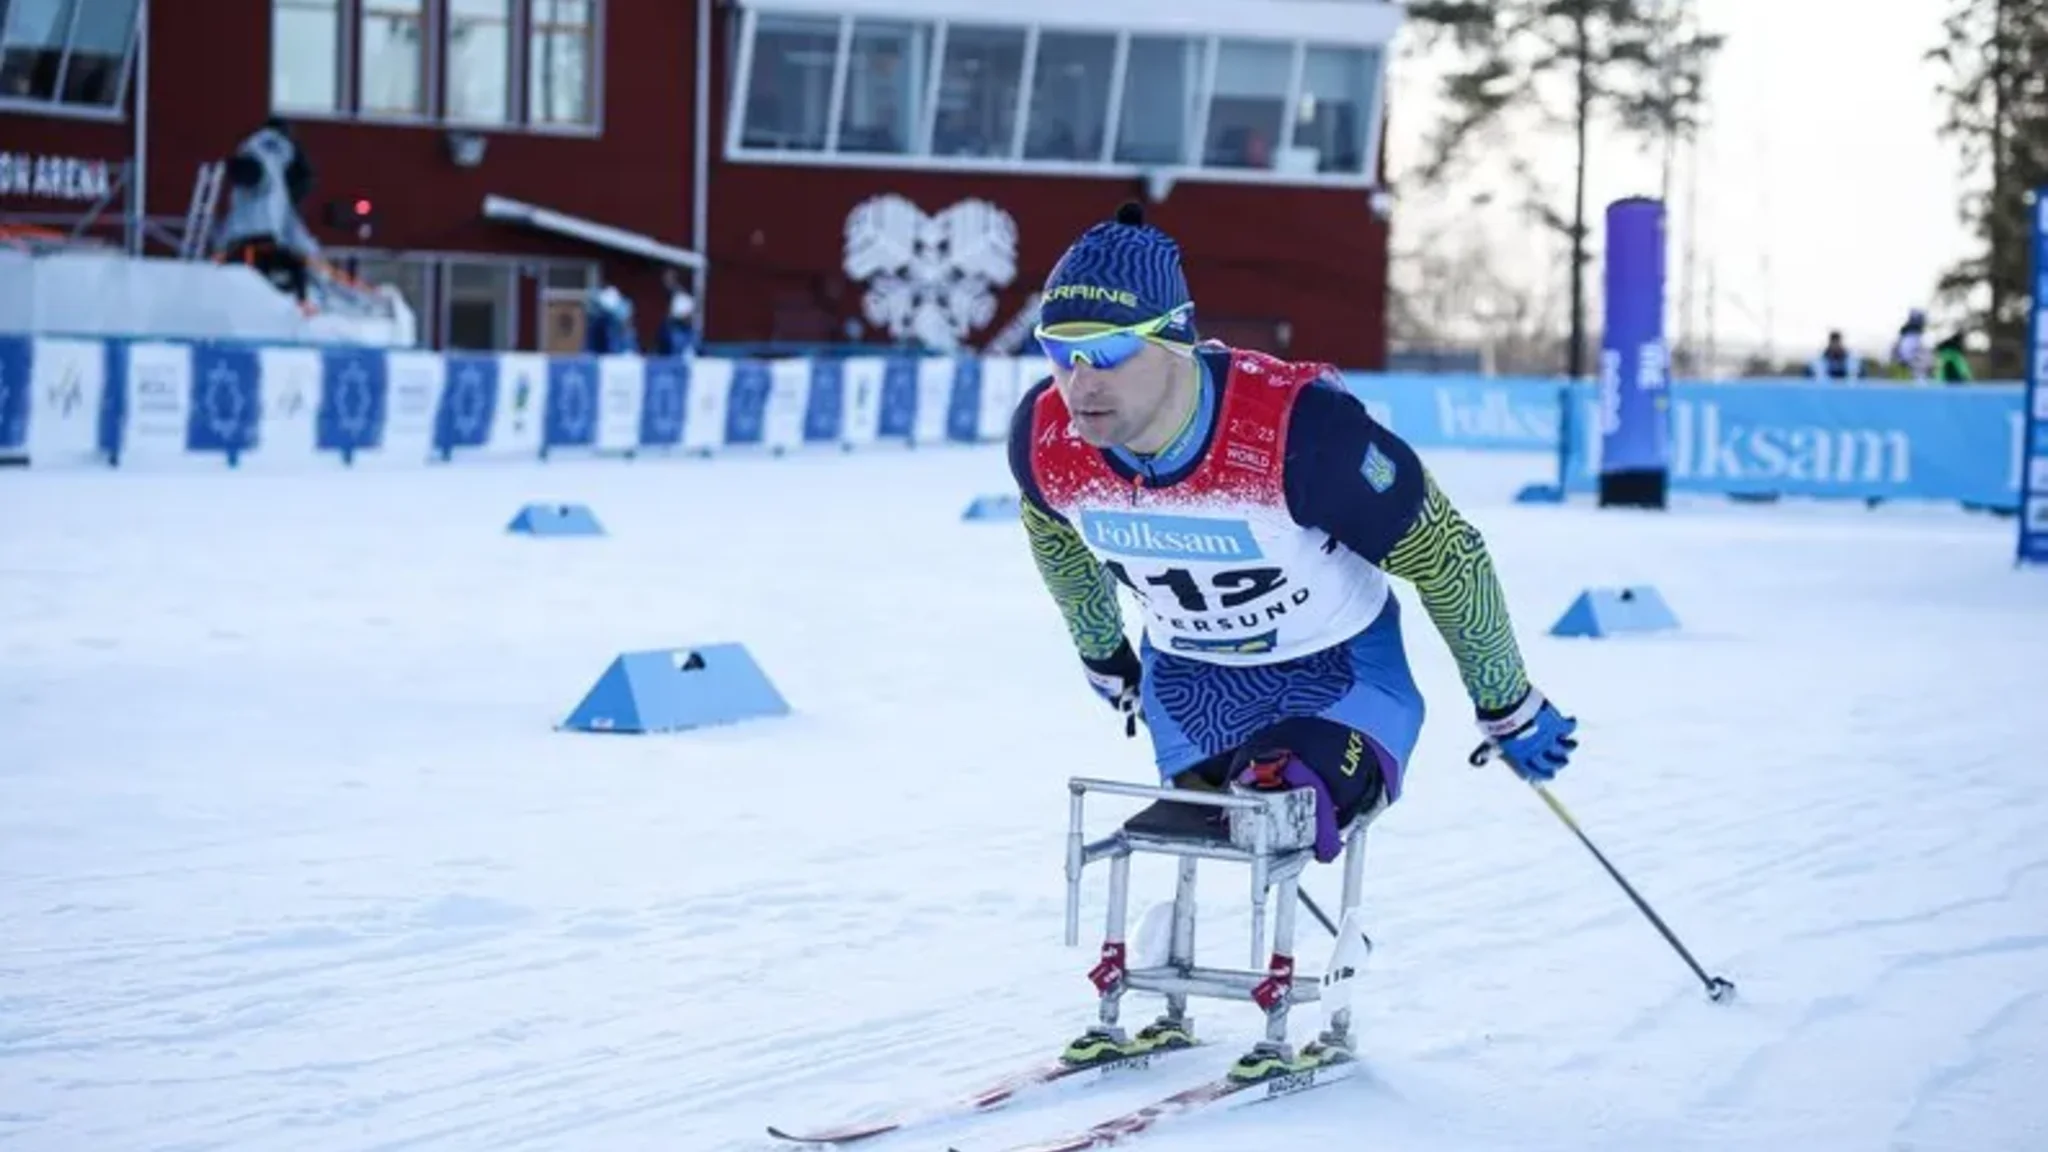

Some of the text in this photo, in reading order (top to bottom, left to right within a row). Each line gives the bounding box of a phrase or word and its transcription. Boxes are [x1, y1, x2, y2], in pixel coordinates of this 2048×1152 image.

[34, 154, 110, 201] ARENA
[1227, 448, 1270, 467] WORLD
[1585, 399, 1911, 484] lksam
[1095, 519, 1241, 554] Folksam
